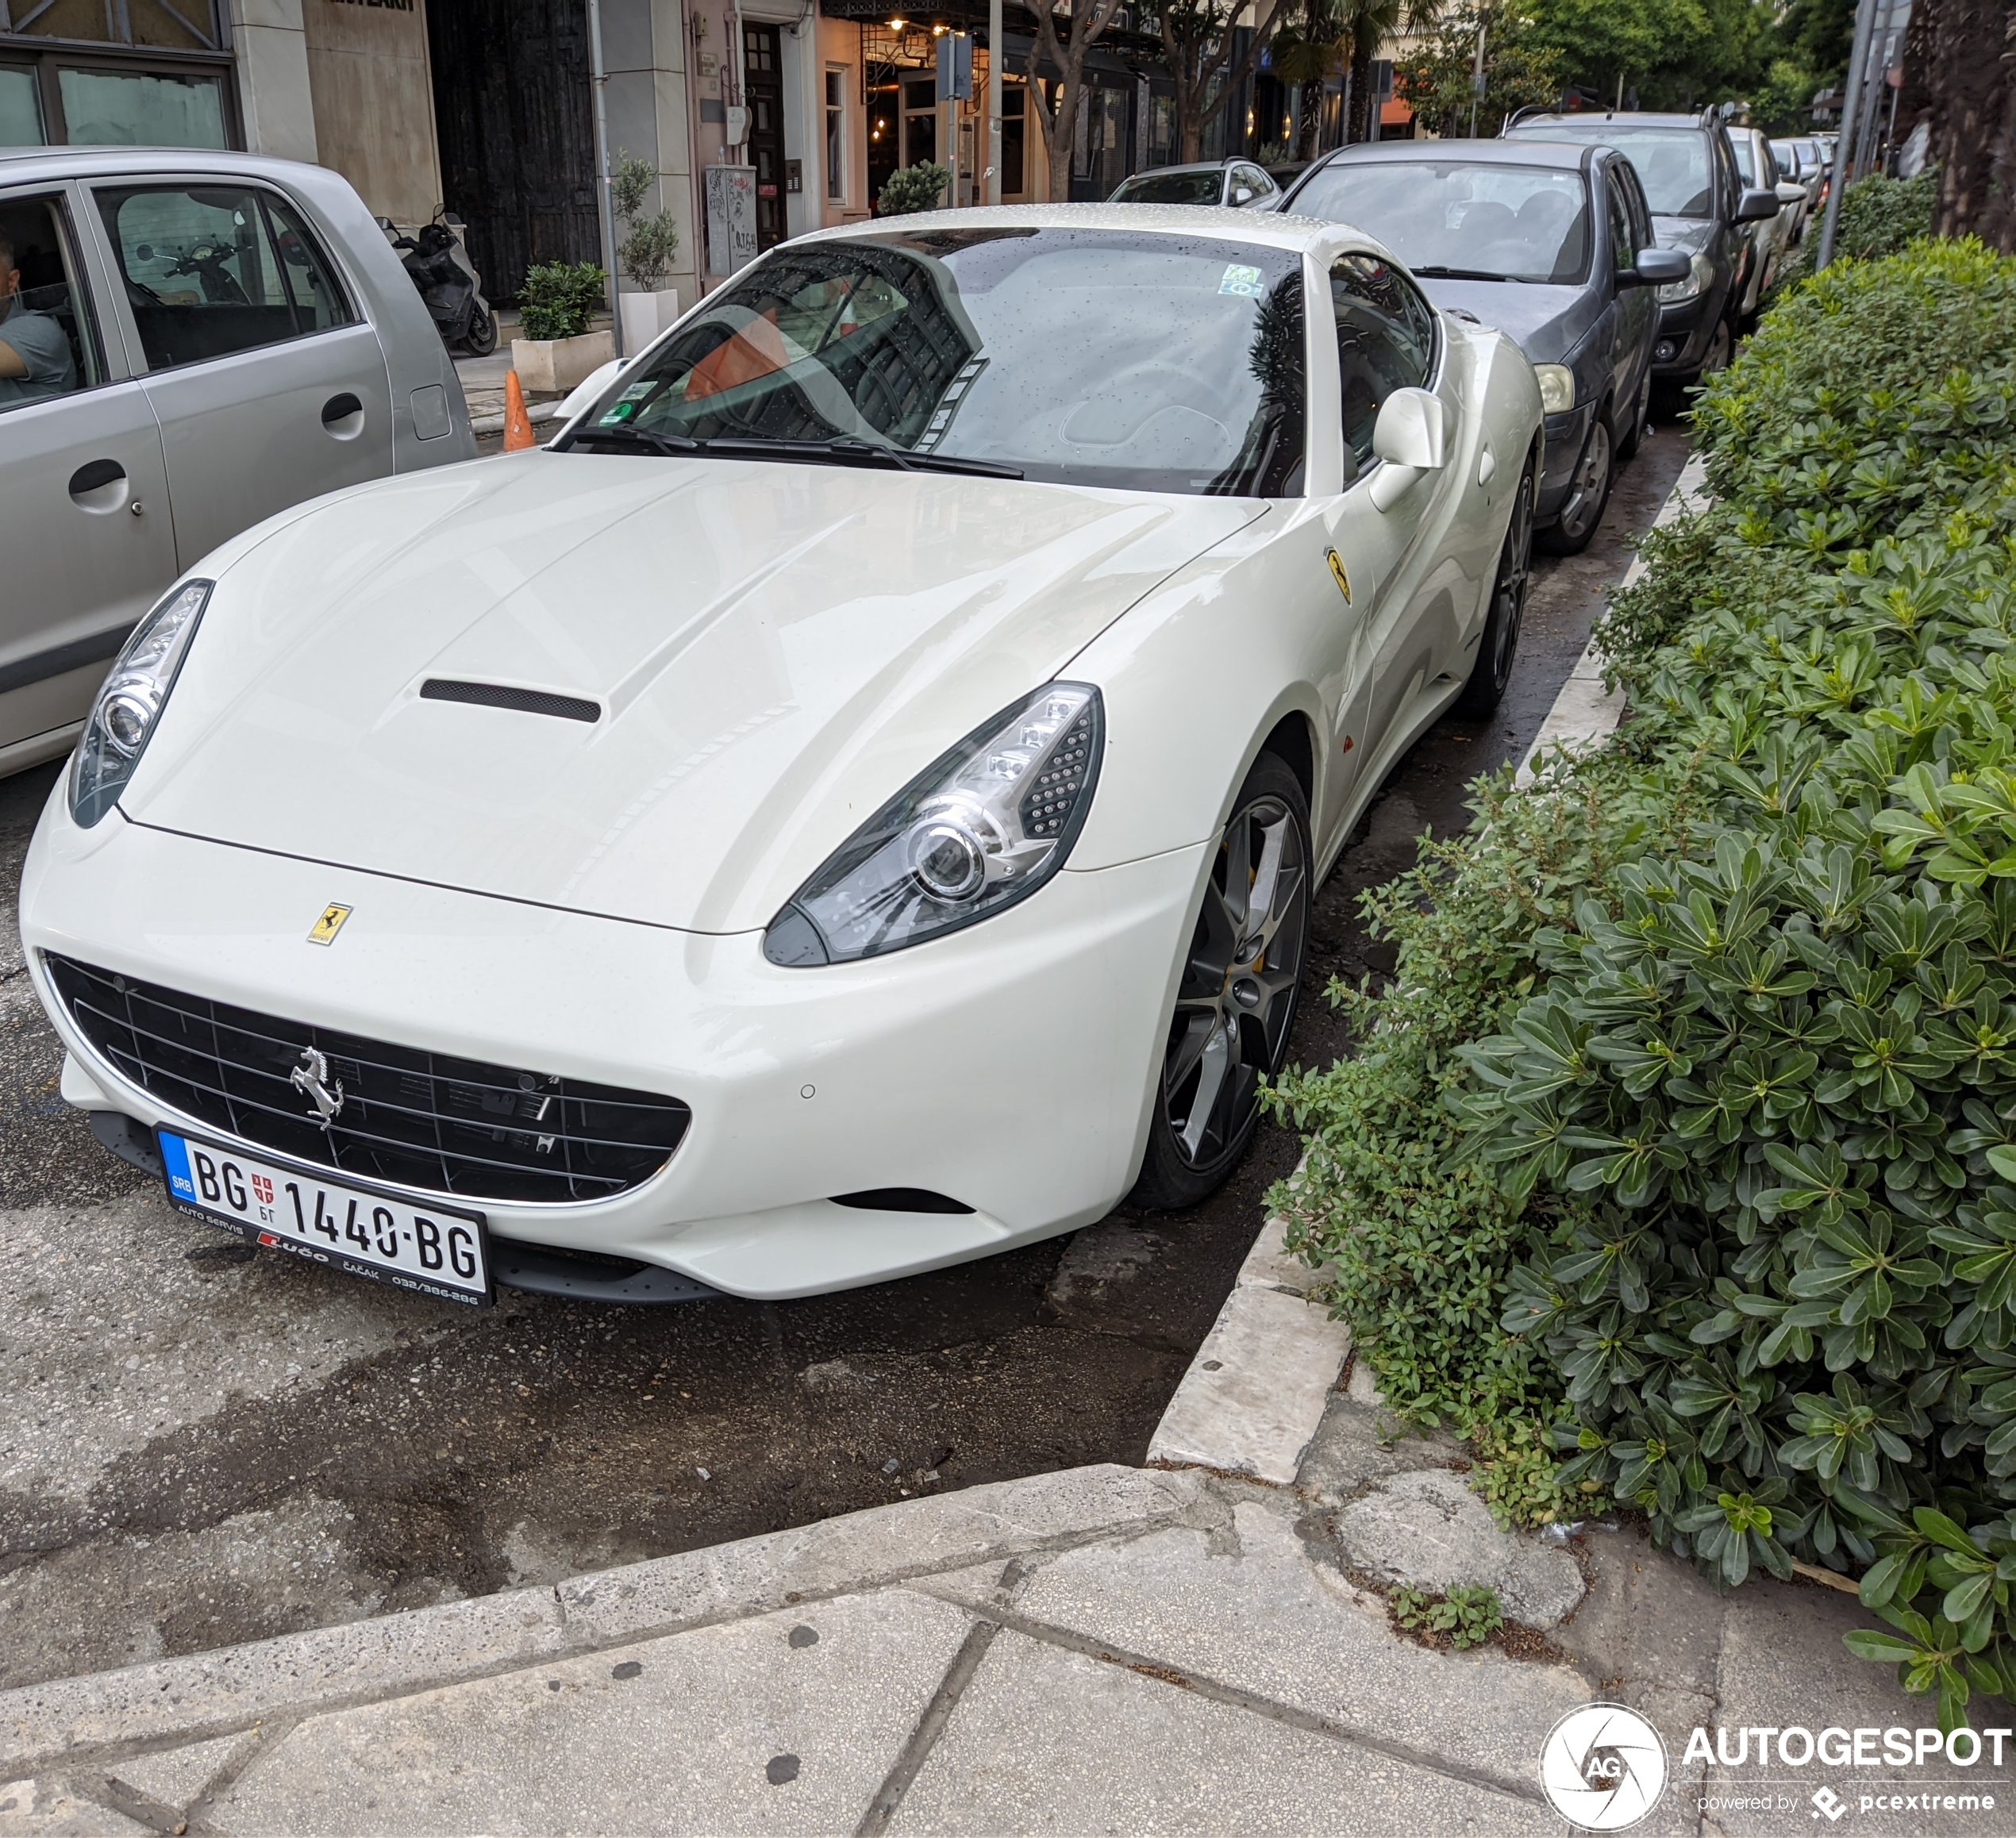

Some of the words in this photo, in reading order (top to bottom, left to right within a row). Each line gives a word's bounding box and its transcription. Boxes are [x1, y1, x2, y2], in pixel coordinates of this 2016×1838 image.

[172, 1175, 192, 1192] SRB
[194, 1151, 248, 1211] BG
[179, 1205, 204, 1220] AUTO
[206, 1216, 244, 1235] SERVIS
[343, 1262, 379, 1279] ČAČAK
[392, 1277, 478, 1305] 032/386-286
